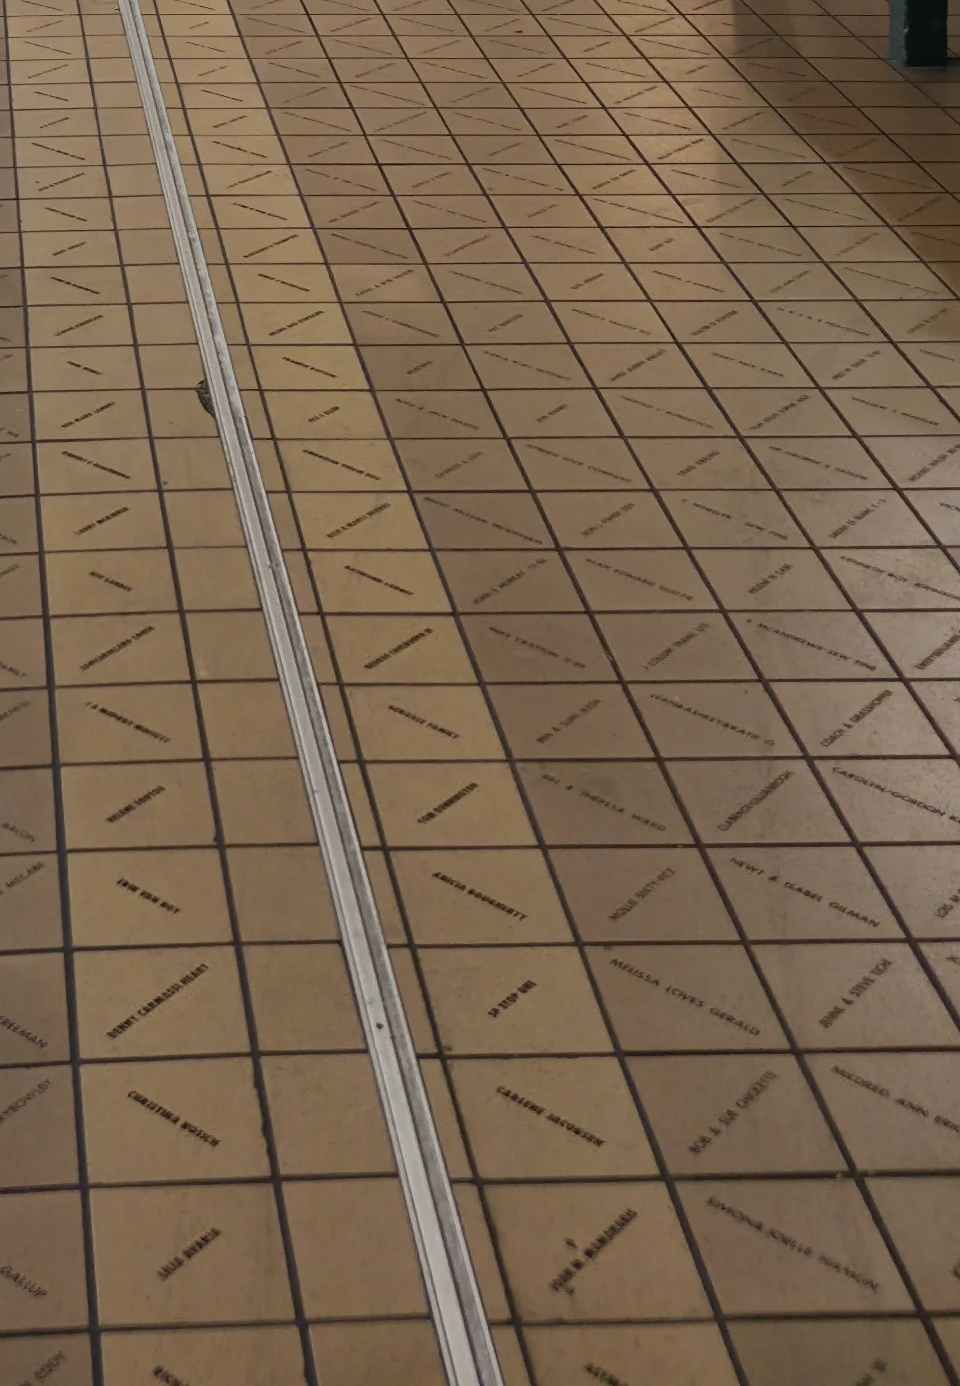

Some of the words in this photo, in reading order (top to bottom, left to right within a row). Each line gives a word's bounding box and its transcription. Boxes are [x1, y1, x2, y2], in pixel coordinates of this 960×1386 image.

[828, 901, 880, 927] GILMAN
[609, 958, 659, 986] MELISSA
[664, 985, 704, 1007] LOVES
[709, 1007, 760, 1036] GERALD
[894, 1097, 929, 1117] ANN
